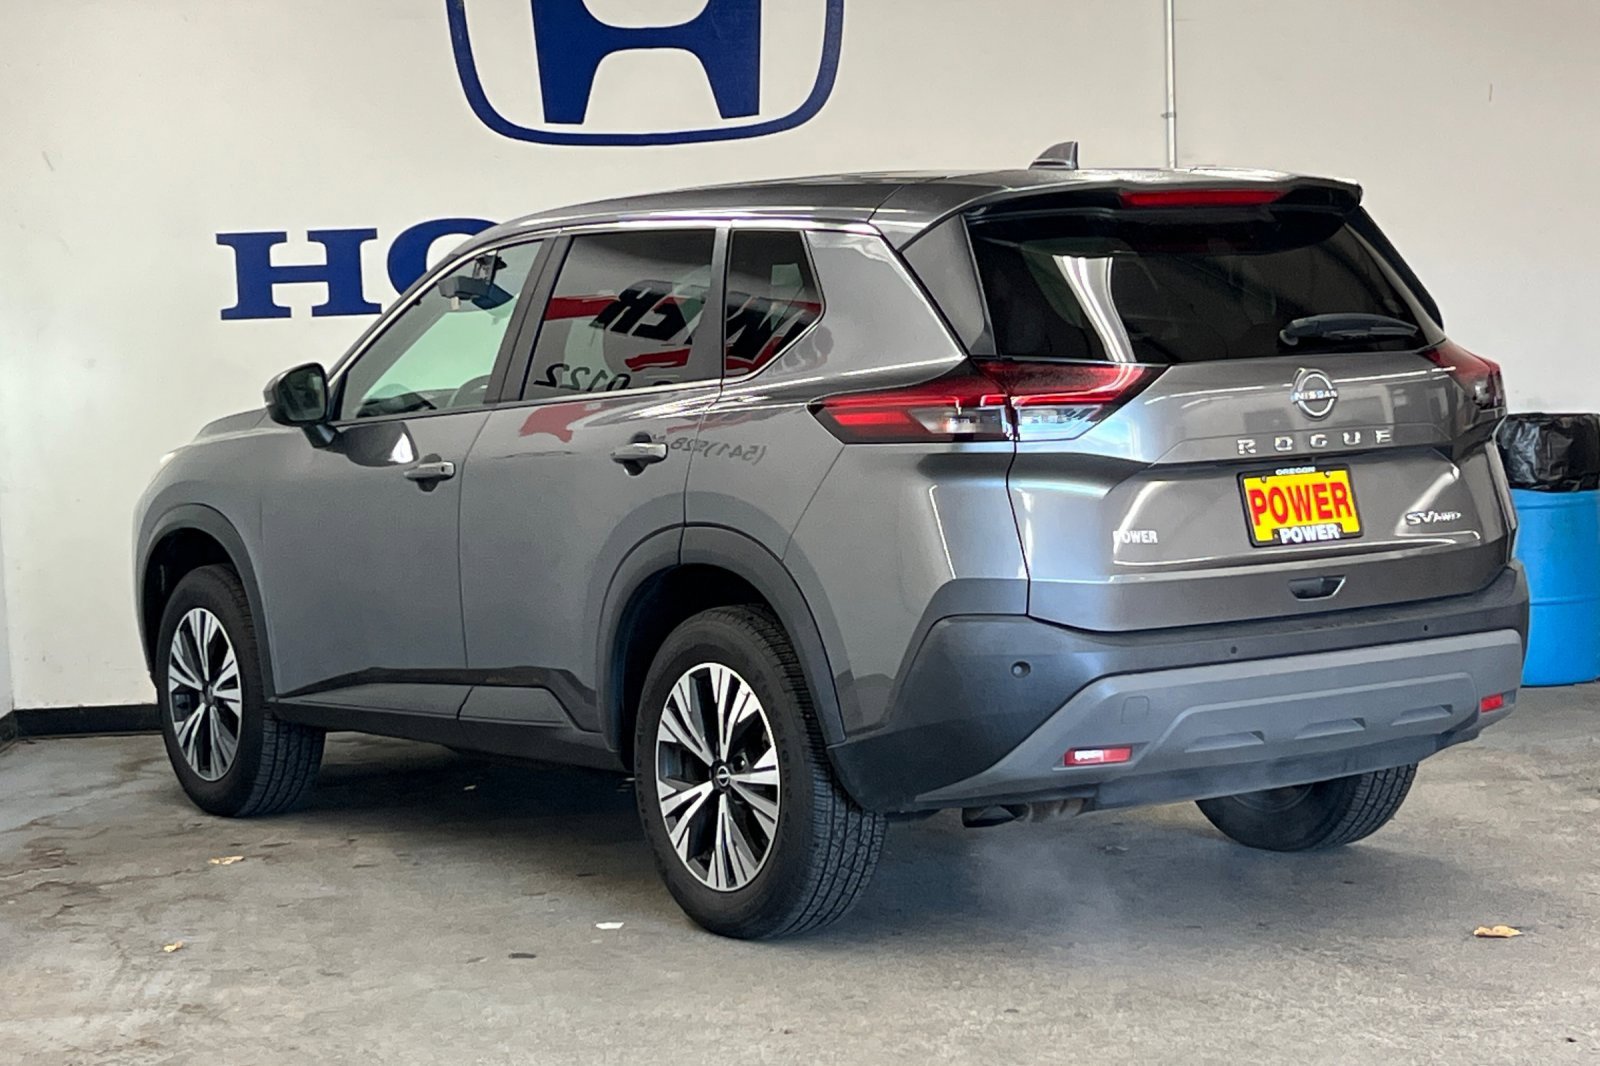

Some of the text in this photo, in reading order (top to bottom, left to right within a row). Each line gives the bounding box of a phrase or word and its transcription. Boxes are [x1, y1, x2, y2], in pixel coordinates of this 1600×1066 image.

[1294, 389, 1337, 400] NISSAN
[1237, 429, 1392, 454] ROGUE
[1248, 482, 1352, 526] POWER
[1112, 530, 1158, 544] POWER
[1279, 524, 1340, 544] POWER
